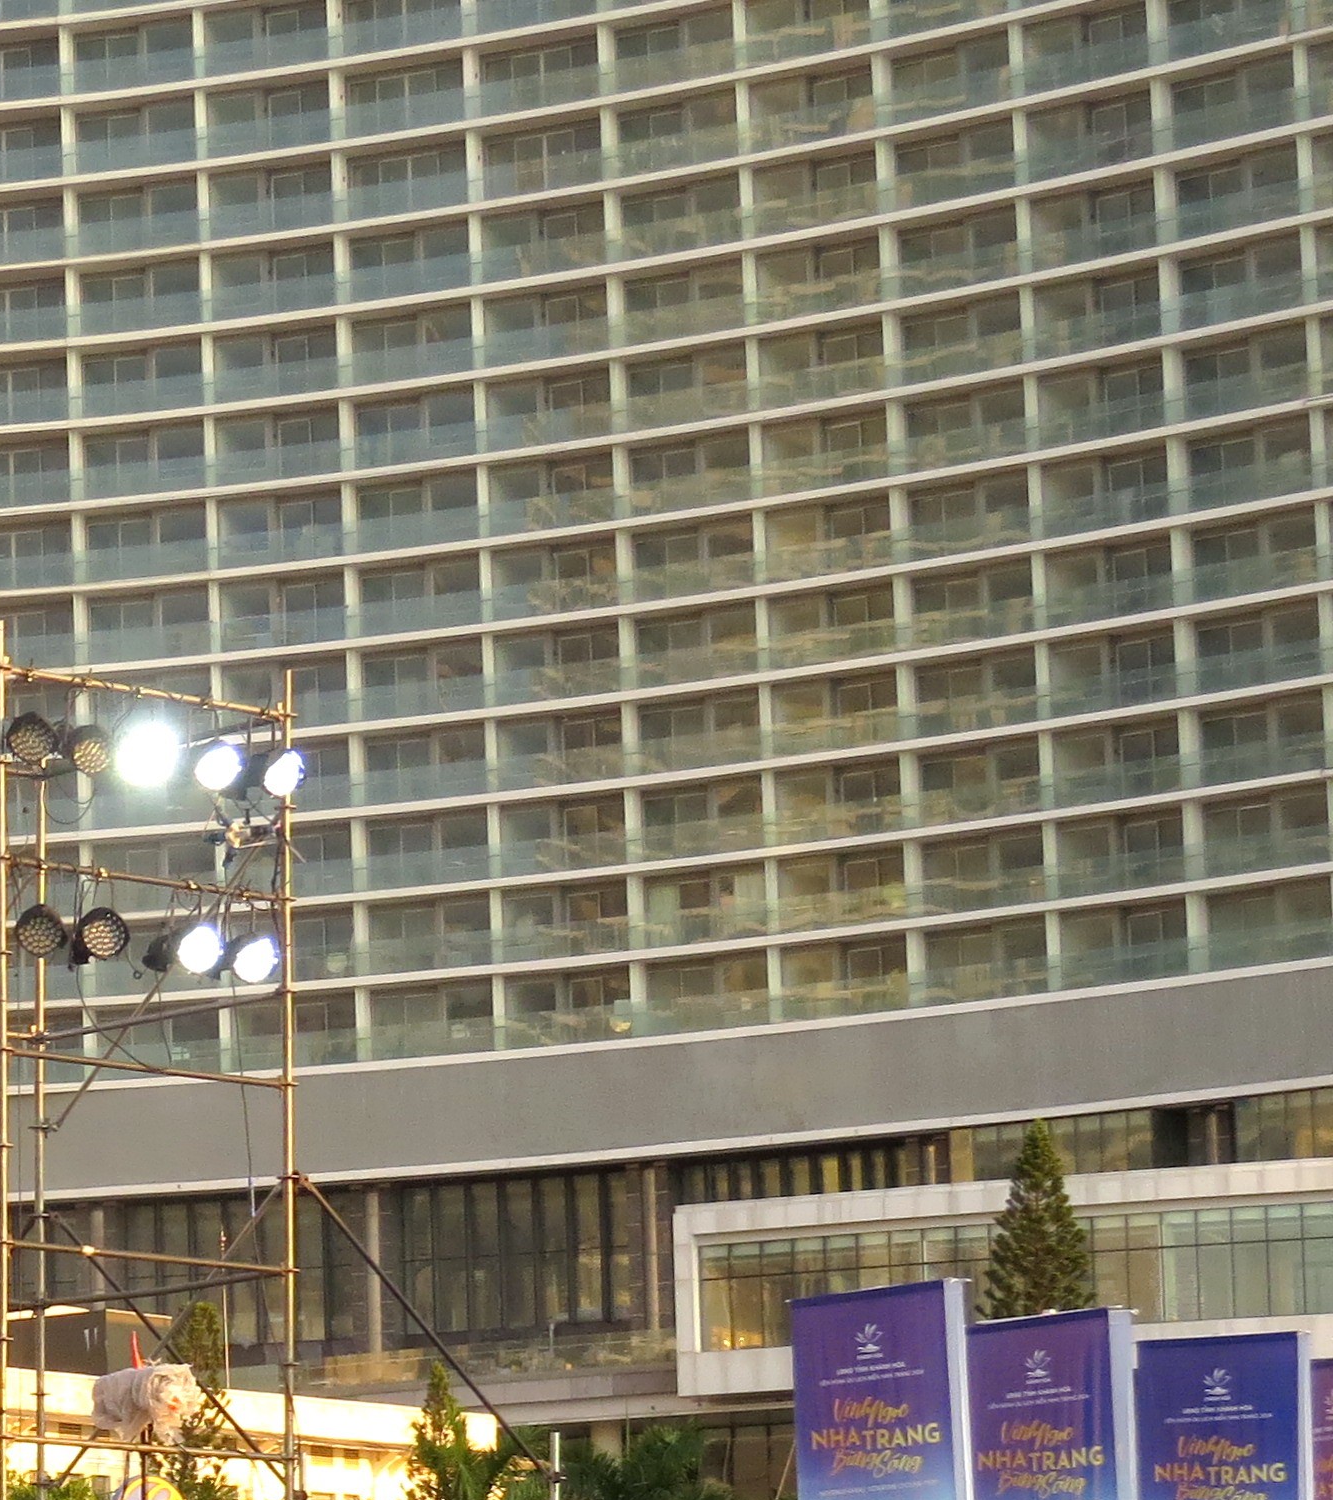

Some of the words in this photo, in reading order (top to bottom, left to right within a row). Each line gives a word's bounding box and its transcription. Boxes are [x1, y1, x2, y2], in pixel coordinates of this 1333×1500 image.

[811, 1427, 861, 1450] NHA
[862, 1422, 940, 1449] TRANG
[977, 1450, 1026, 1471] NHA
[1028, 1446, 1104, 1471] TRANG
[1154, 1462, 1204, 1482] NHA
[1207, 1462, 1287, 1486] TRANG
